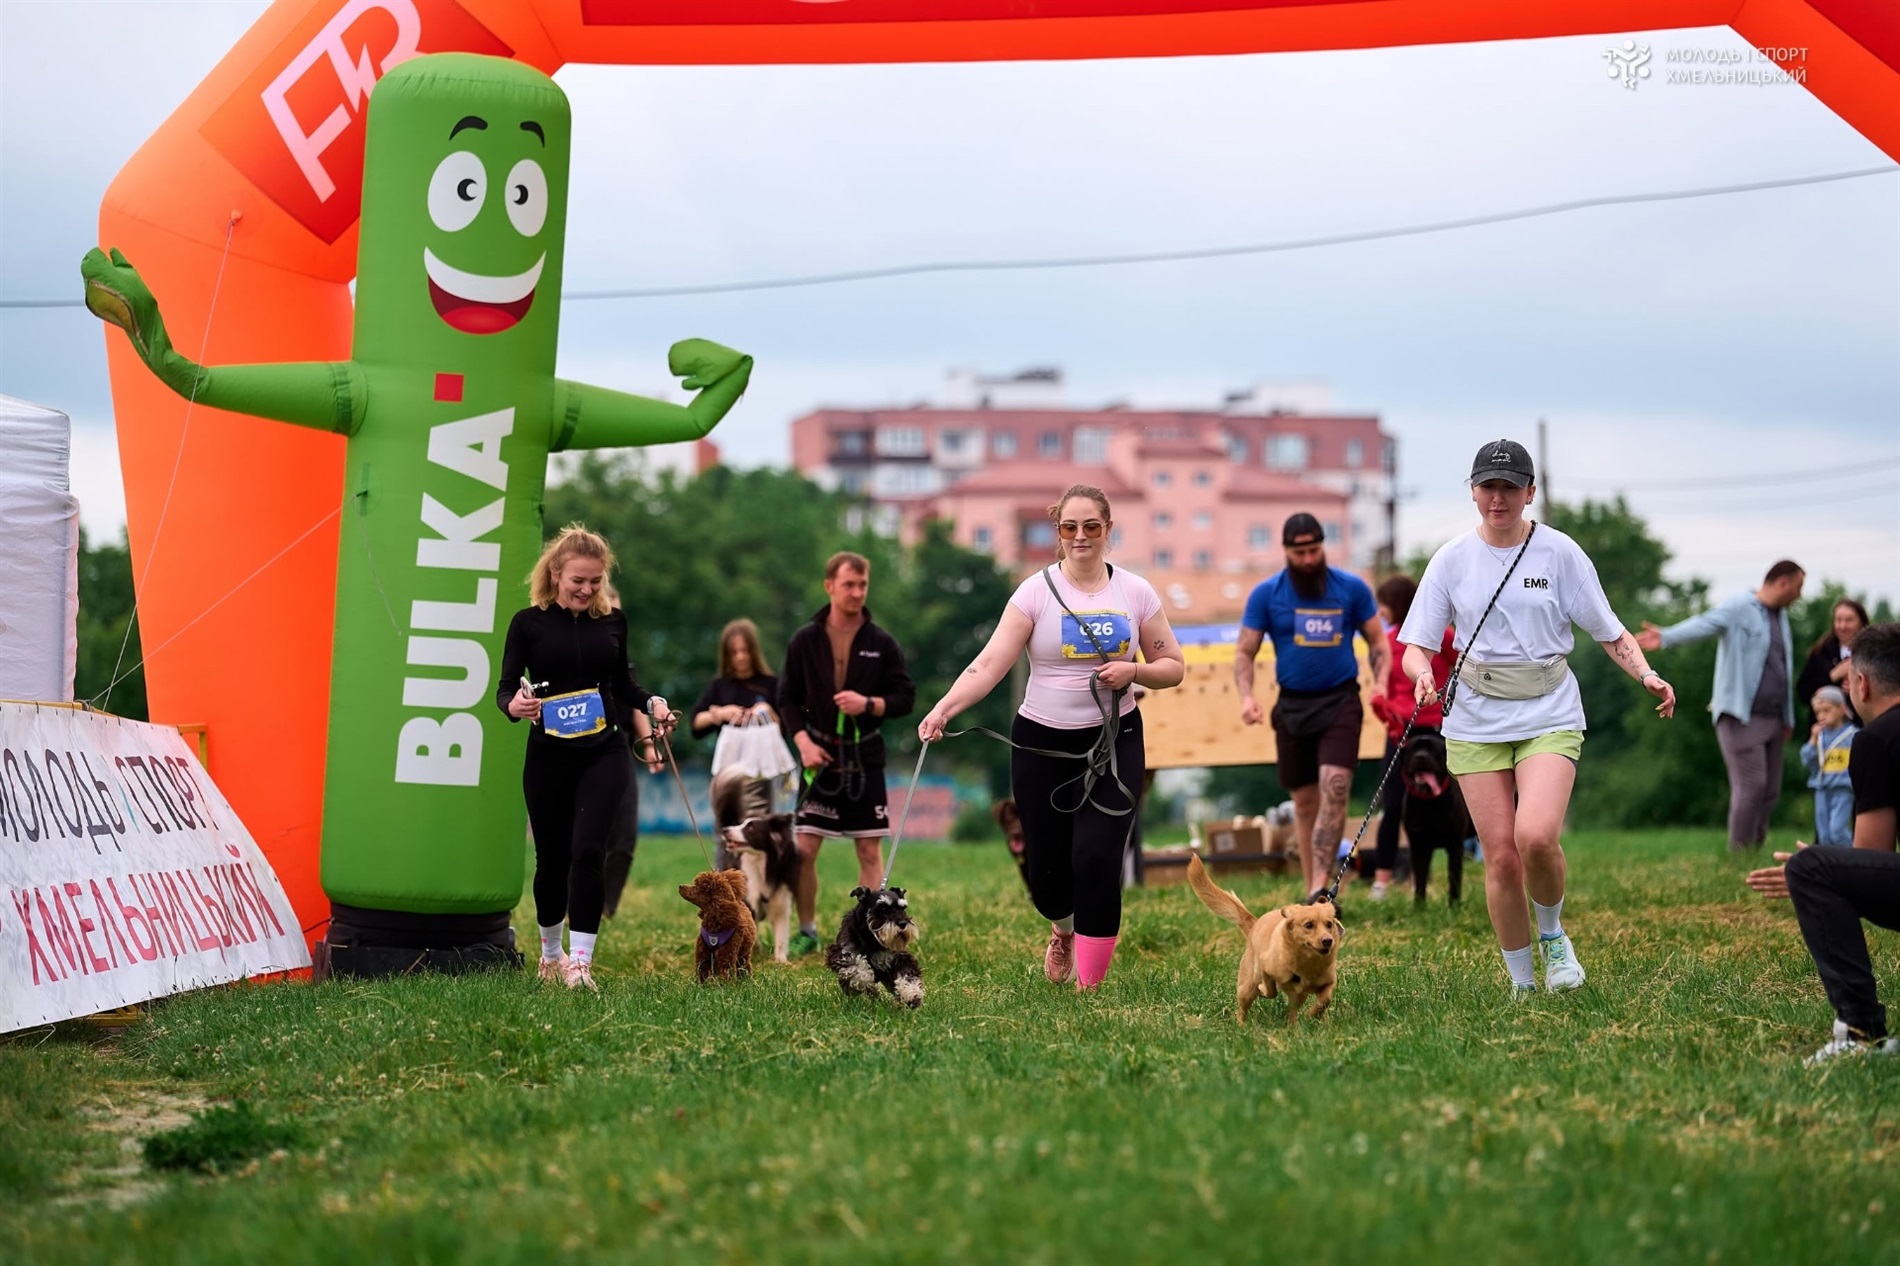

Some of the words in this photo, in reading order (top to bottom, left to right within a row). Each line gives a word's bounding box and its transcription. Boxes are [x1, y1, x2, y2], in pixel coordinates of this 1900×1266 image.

[395, 406, 516, 787] BULKA
[1523, 577, 1549, 590] EMR
[1305, 618, 1334, 633] 014
[557, 702, 587, 720] 027
[114, 755, 220, 835] СПОРТ
[10, 843, 286, 986] ХМЕЛЬНИЦЬКИЙ
